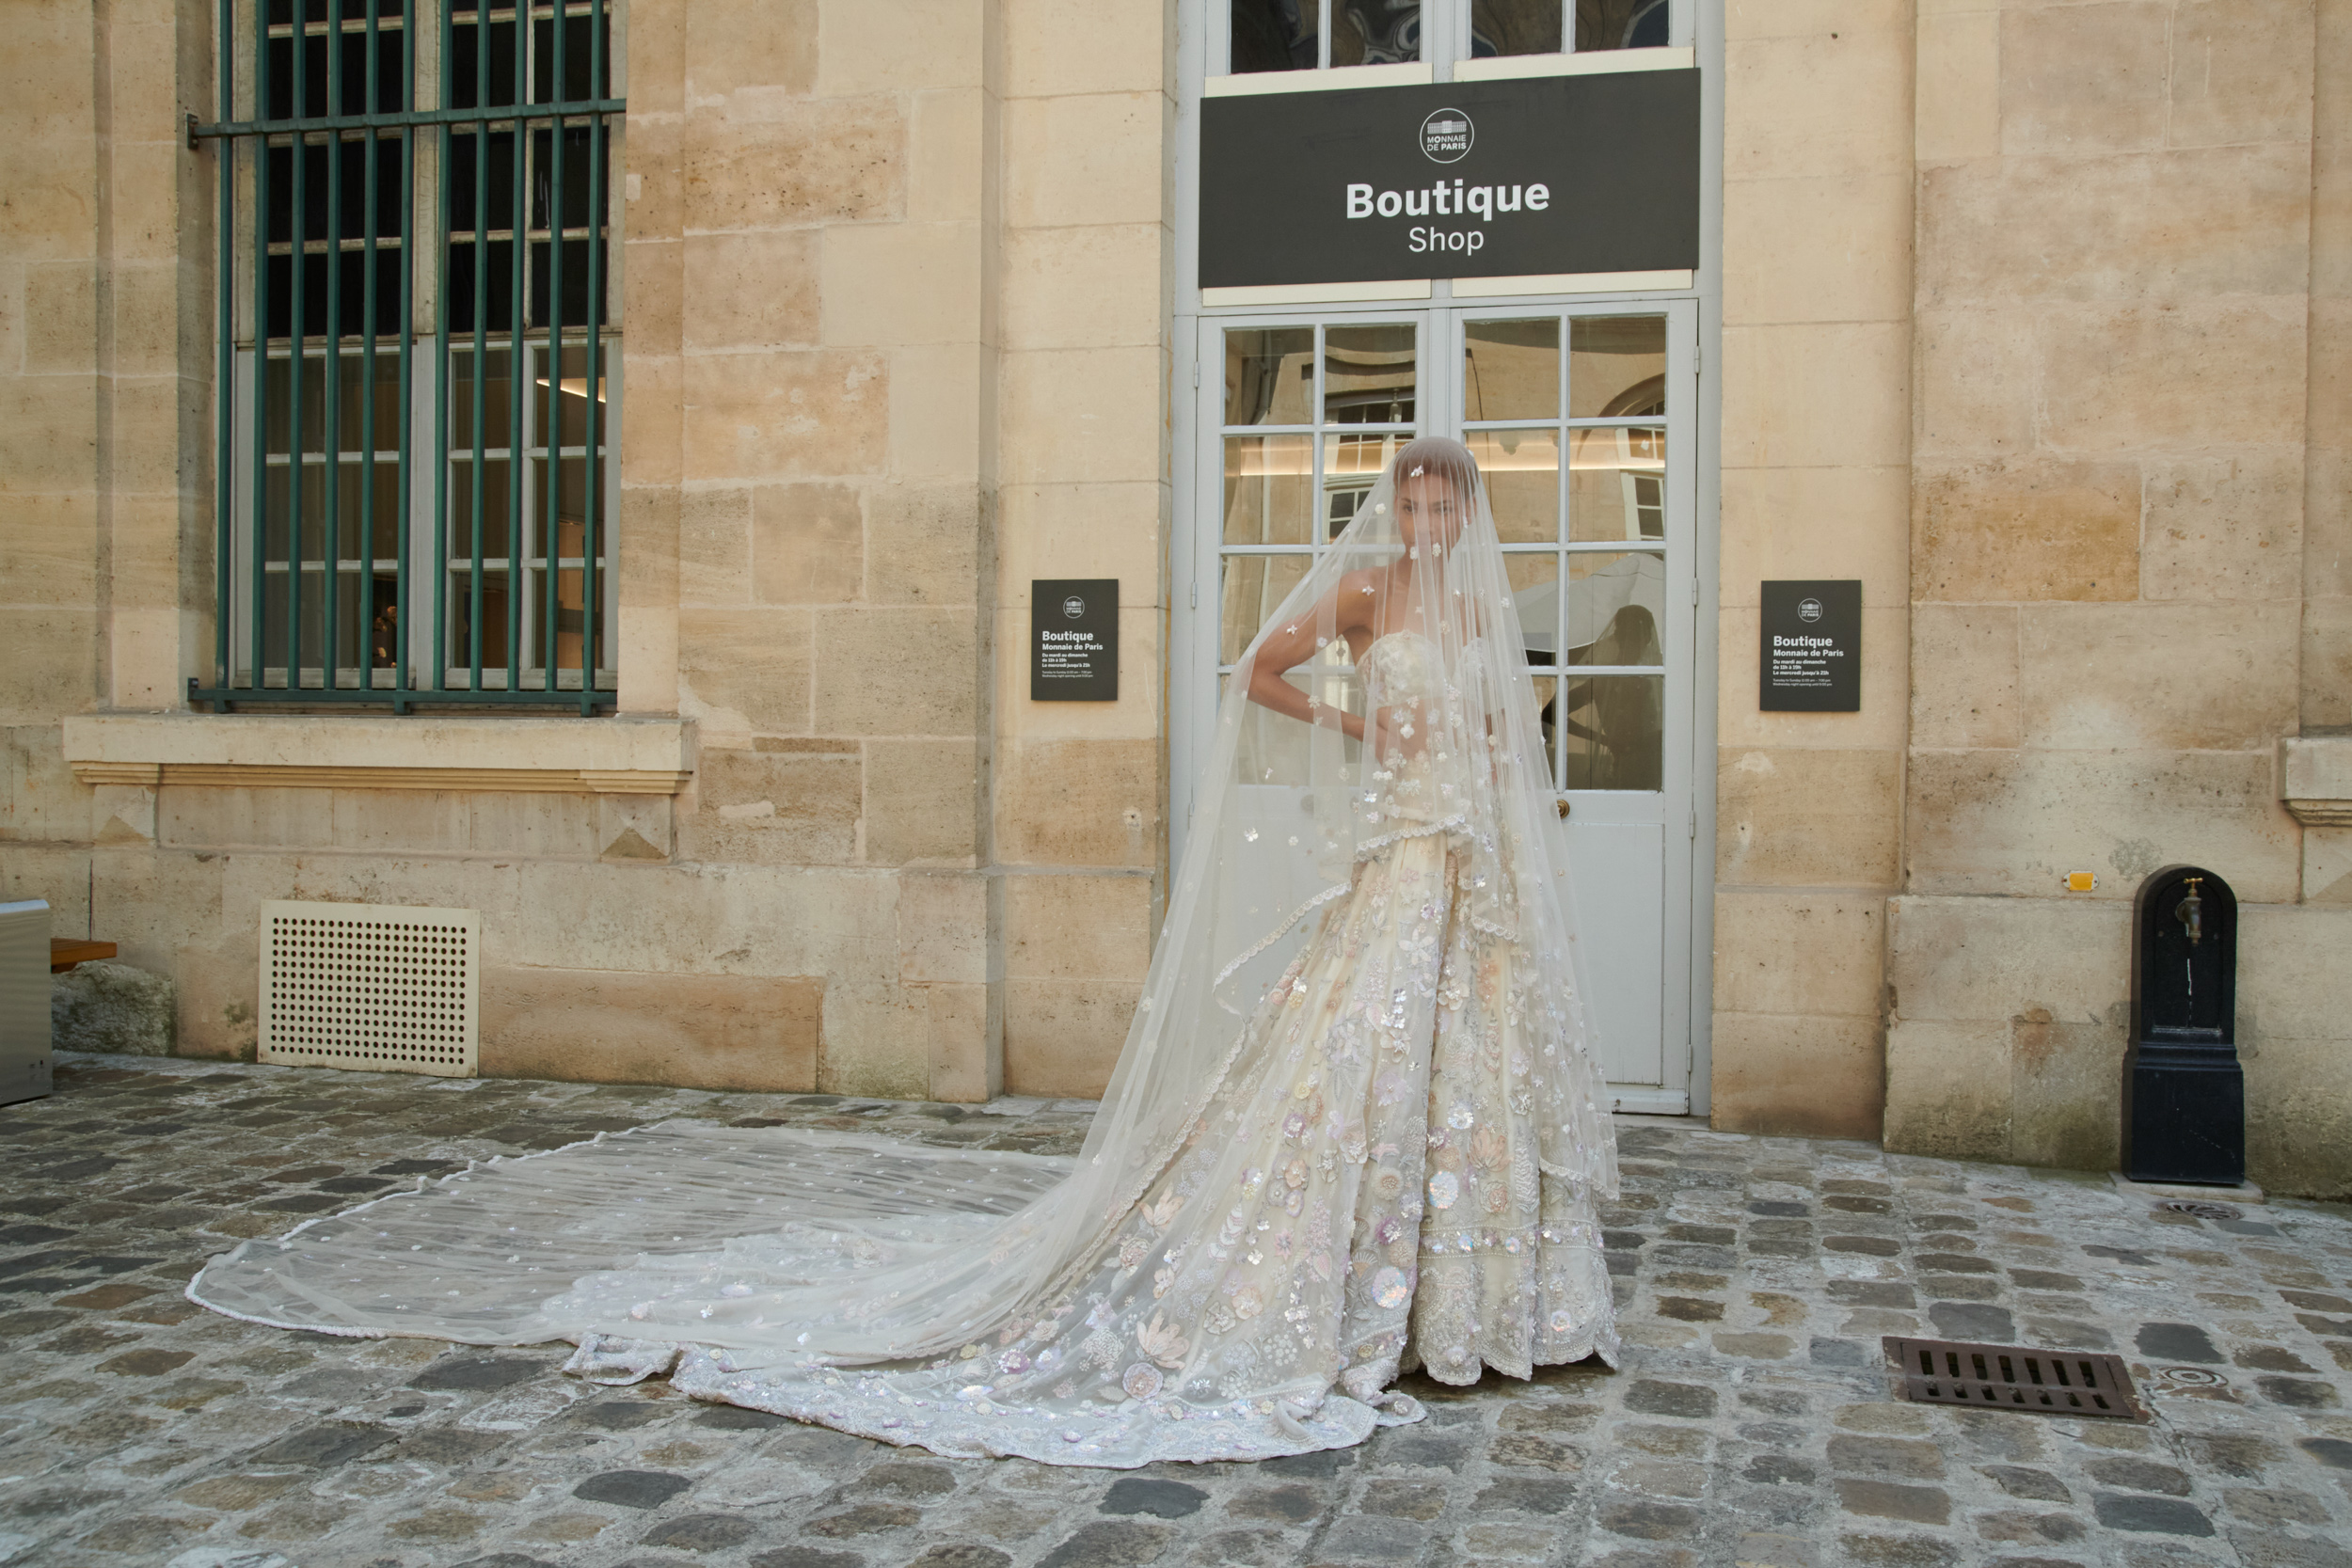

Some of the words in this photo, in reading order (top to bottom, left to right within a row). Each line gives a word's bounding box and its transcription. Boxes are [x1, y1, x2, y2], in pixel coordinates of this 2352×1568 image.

[1427, 135, 1467, 143] MONNAIE
[1346, 179, 1550, 222] Boutique
[1408, 226, 1485, 257] Shop
[1042, 631, 1093, 642] Boutique
[1773, 635, 1833, 648] Boutique
